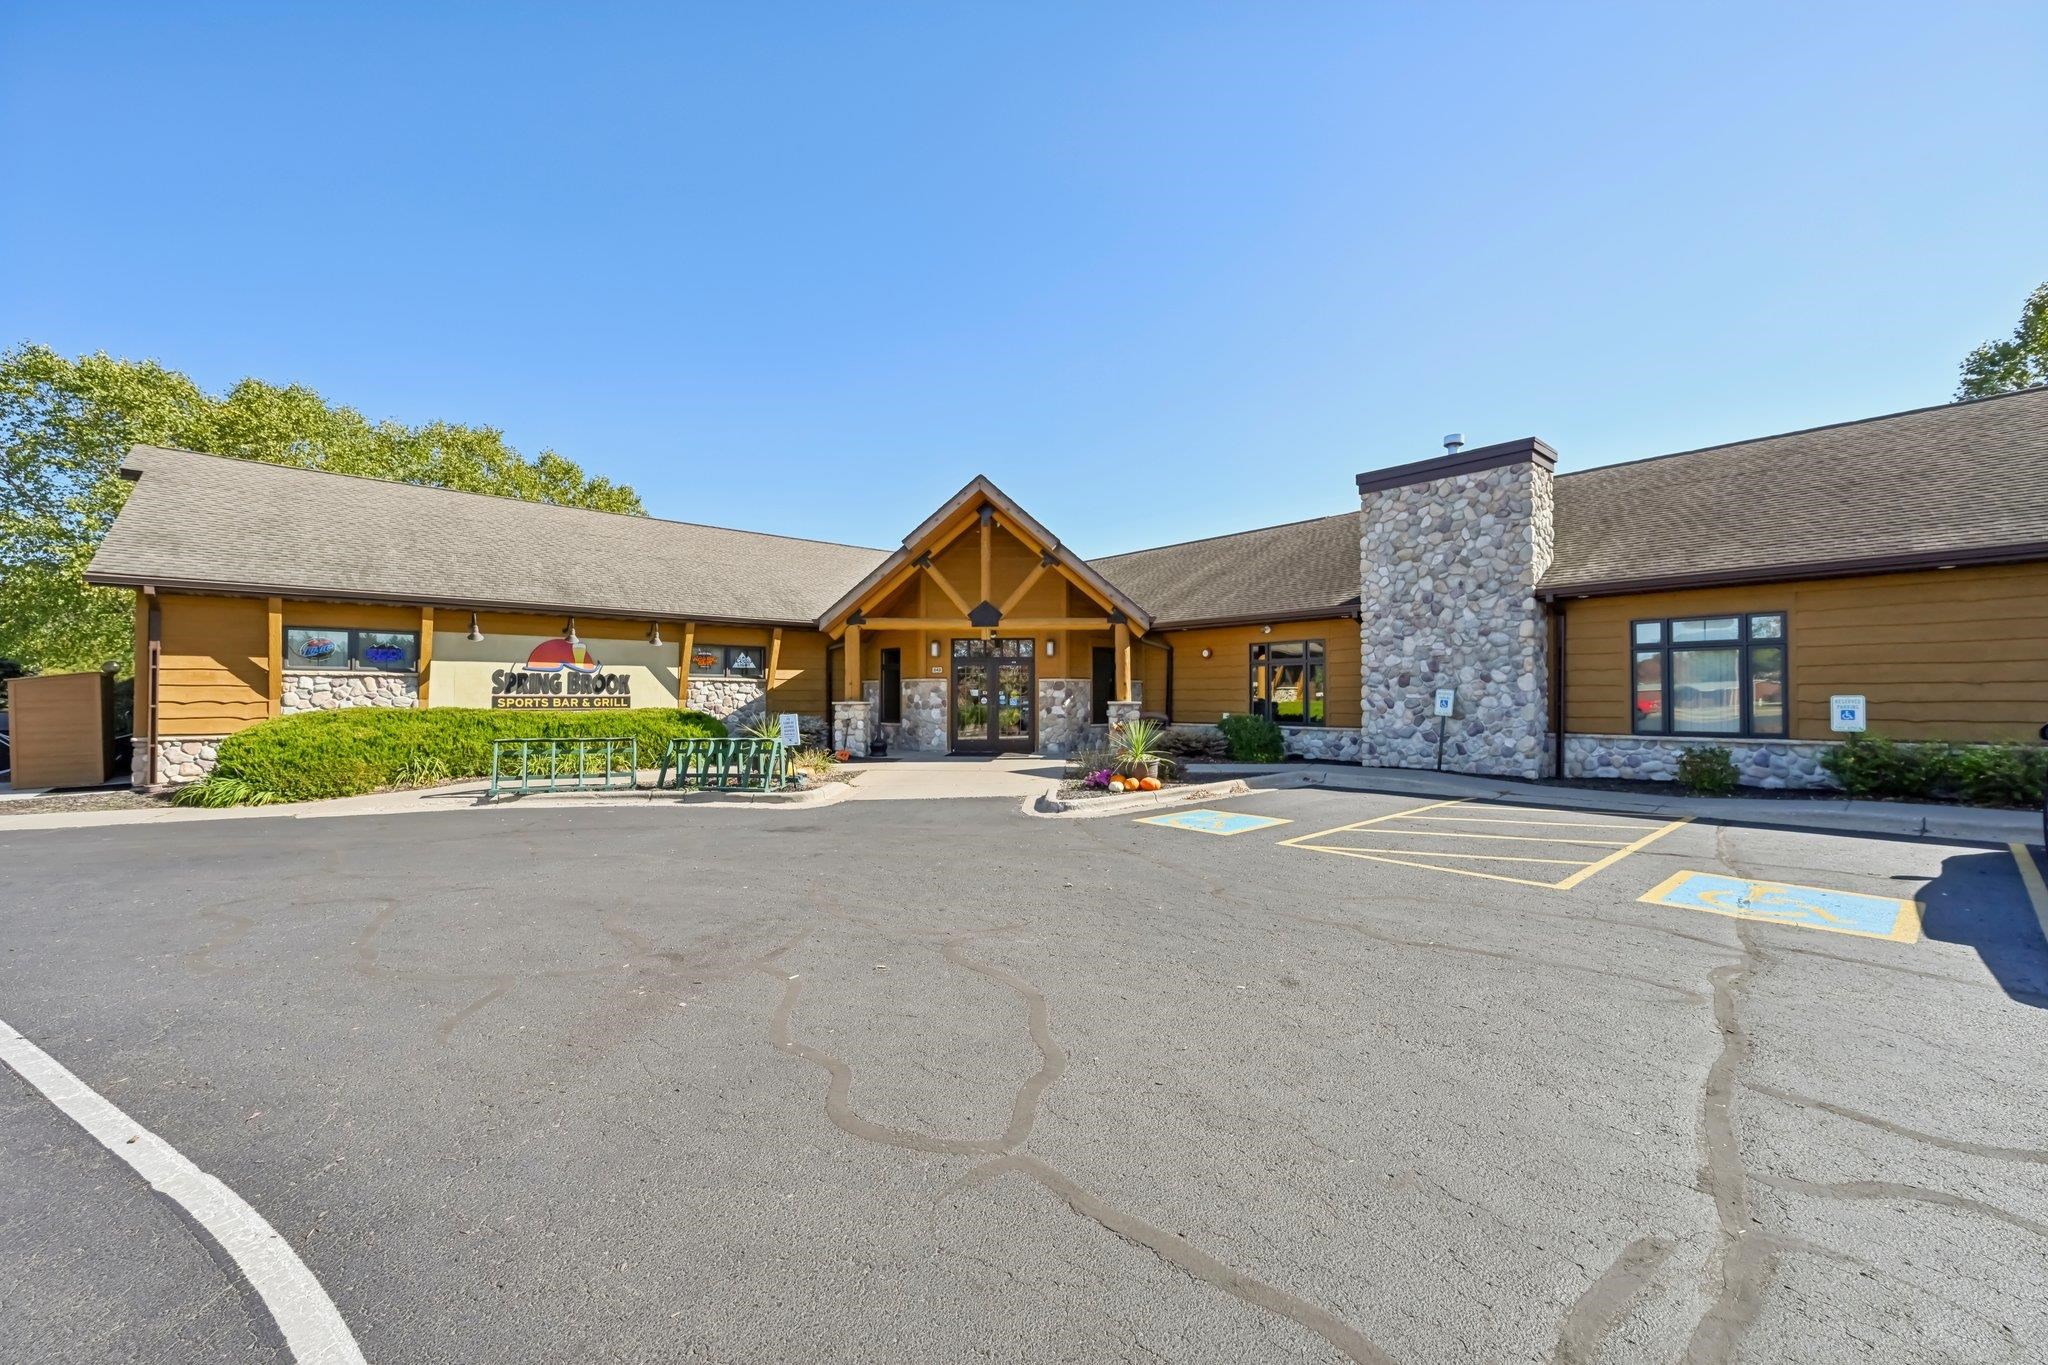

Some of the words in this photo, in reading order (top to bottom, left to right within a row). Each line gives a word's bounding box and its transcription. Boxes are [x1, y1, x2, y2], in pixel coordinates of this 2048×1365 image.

[492, 668, 563, 694] SPRING
[567, 671, 630, 694] BROOK
[497, 698, 549, 707] SPORTS
[552, 698, 579, 707] BAR
[582, 698, 591, 707] &
[593, 698, 628, 707] GRILL
